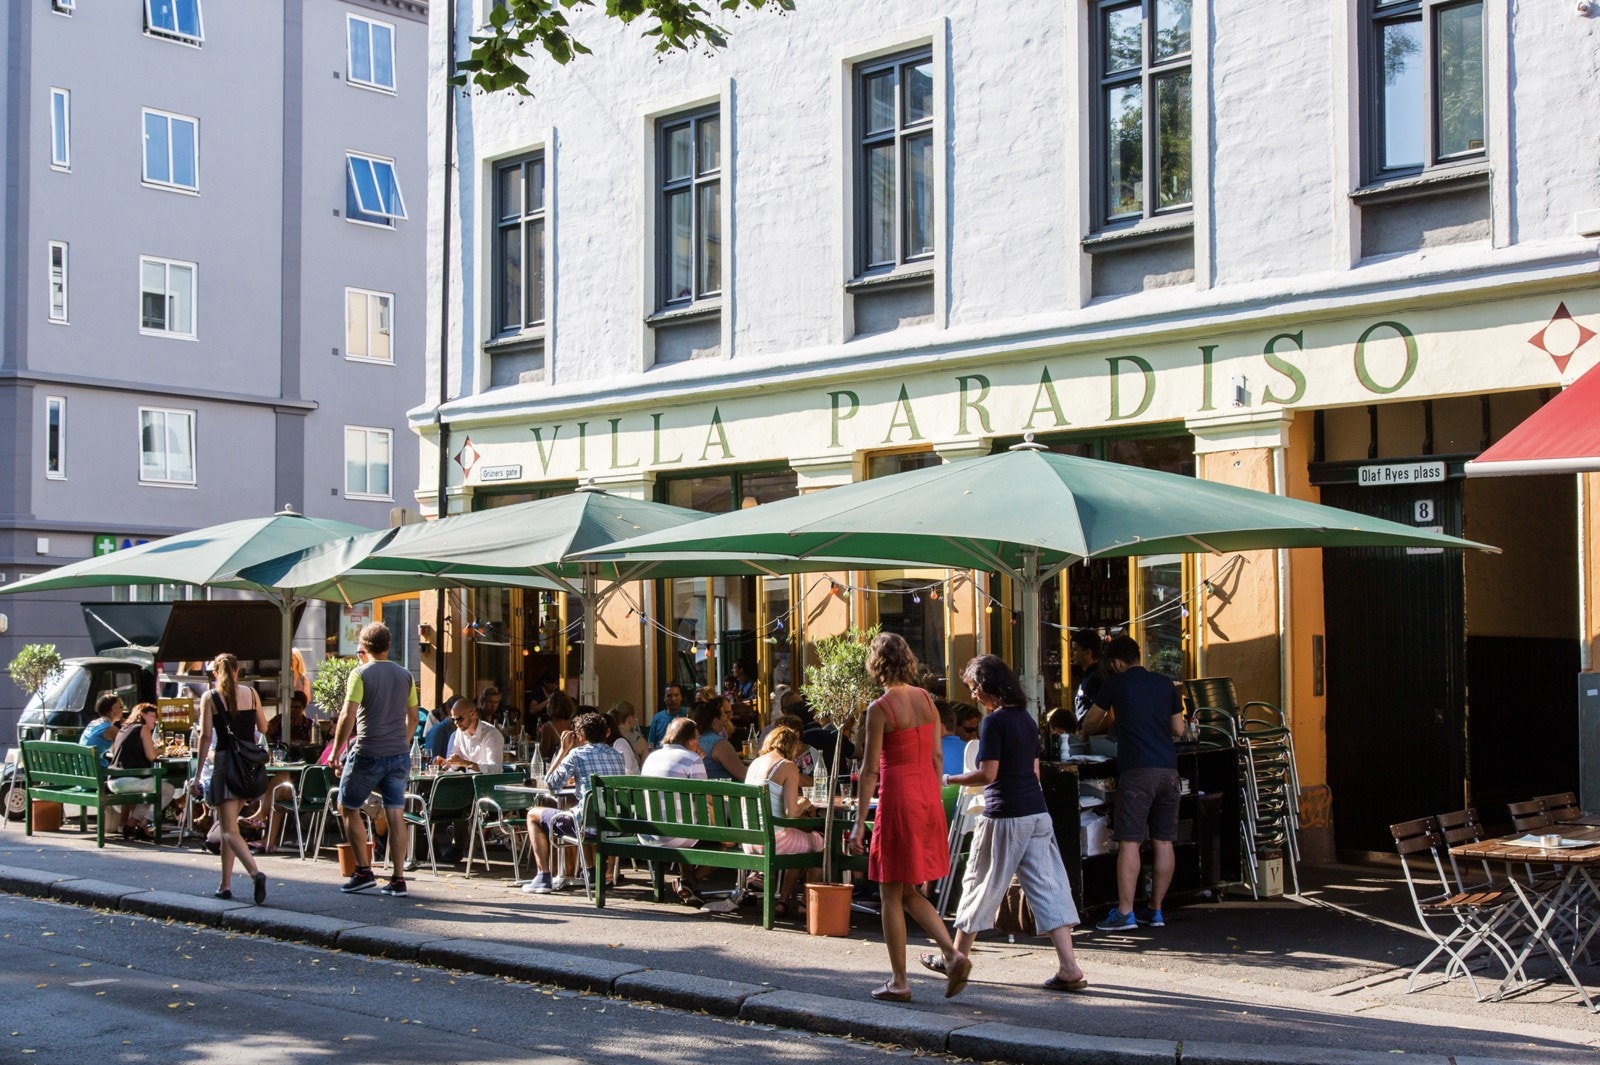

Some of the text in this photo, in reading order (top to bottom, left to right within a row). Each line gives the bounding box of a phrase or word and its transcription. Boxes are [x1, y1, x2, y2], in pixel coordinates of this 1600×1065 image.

[529, 320, 1420, 477] VILLA PARADISO
[1361, 466, 1440, 482] Olaf Ryes plass
[1419, 502, 1429, 519] 8
